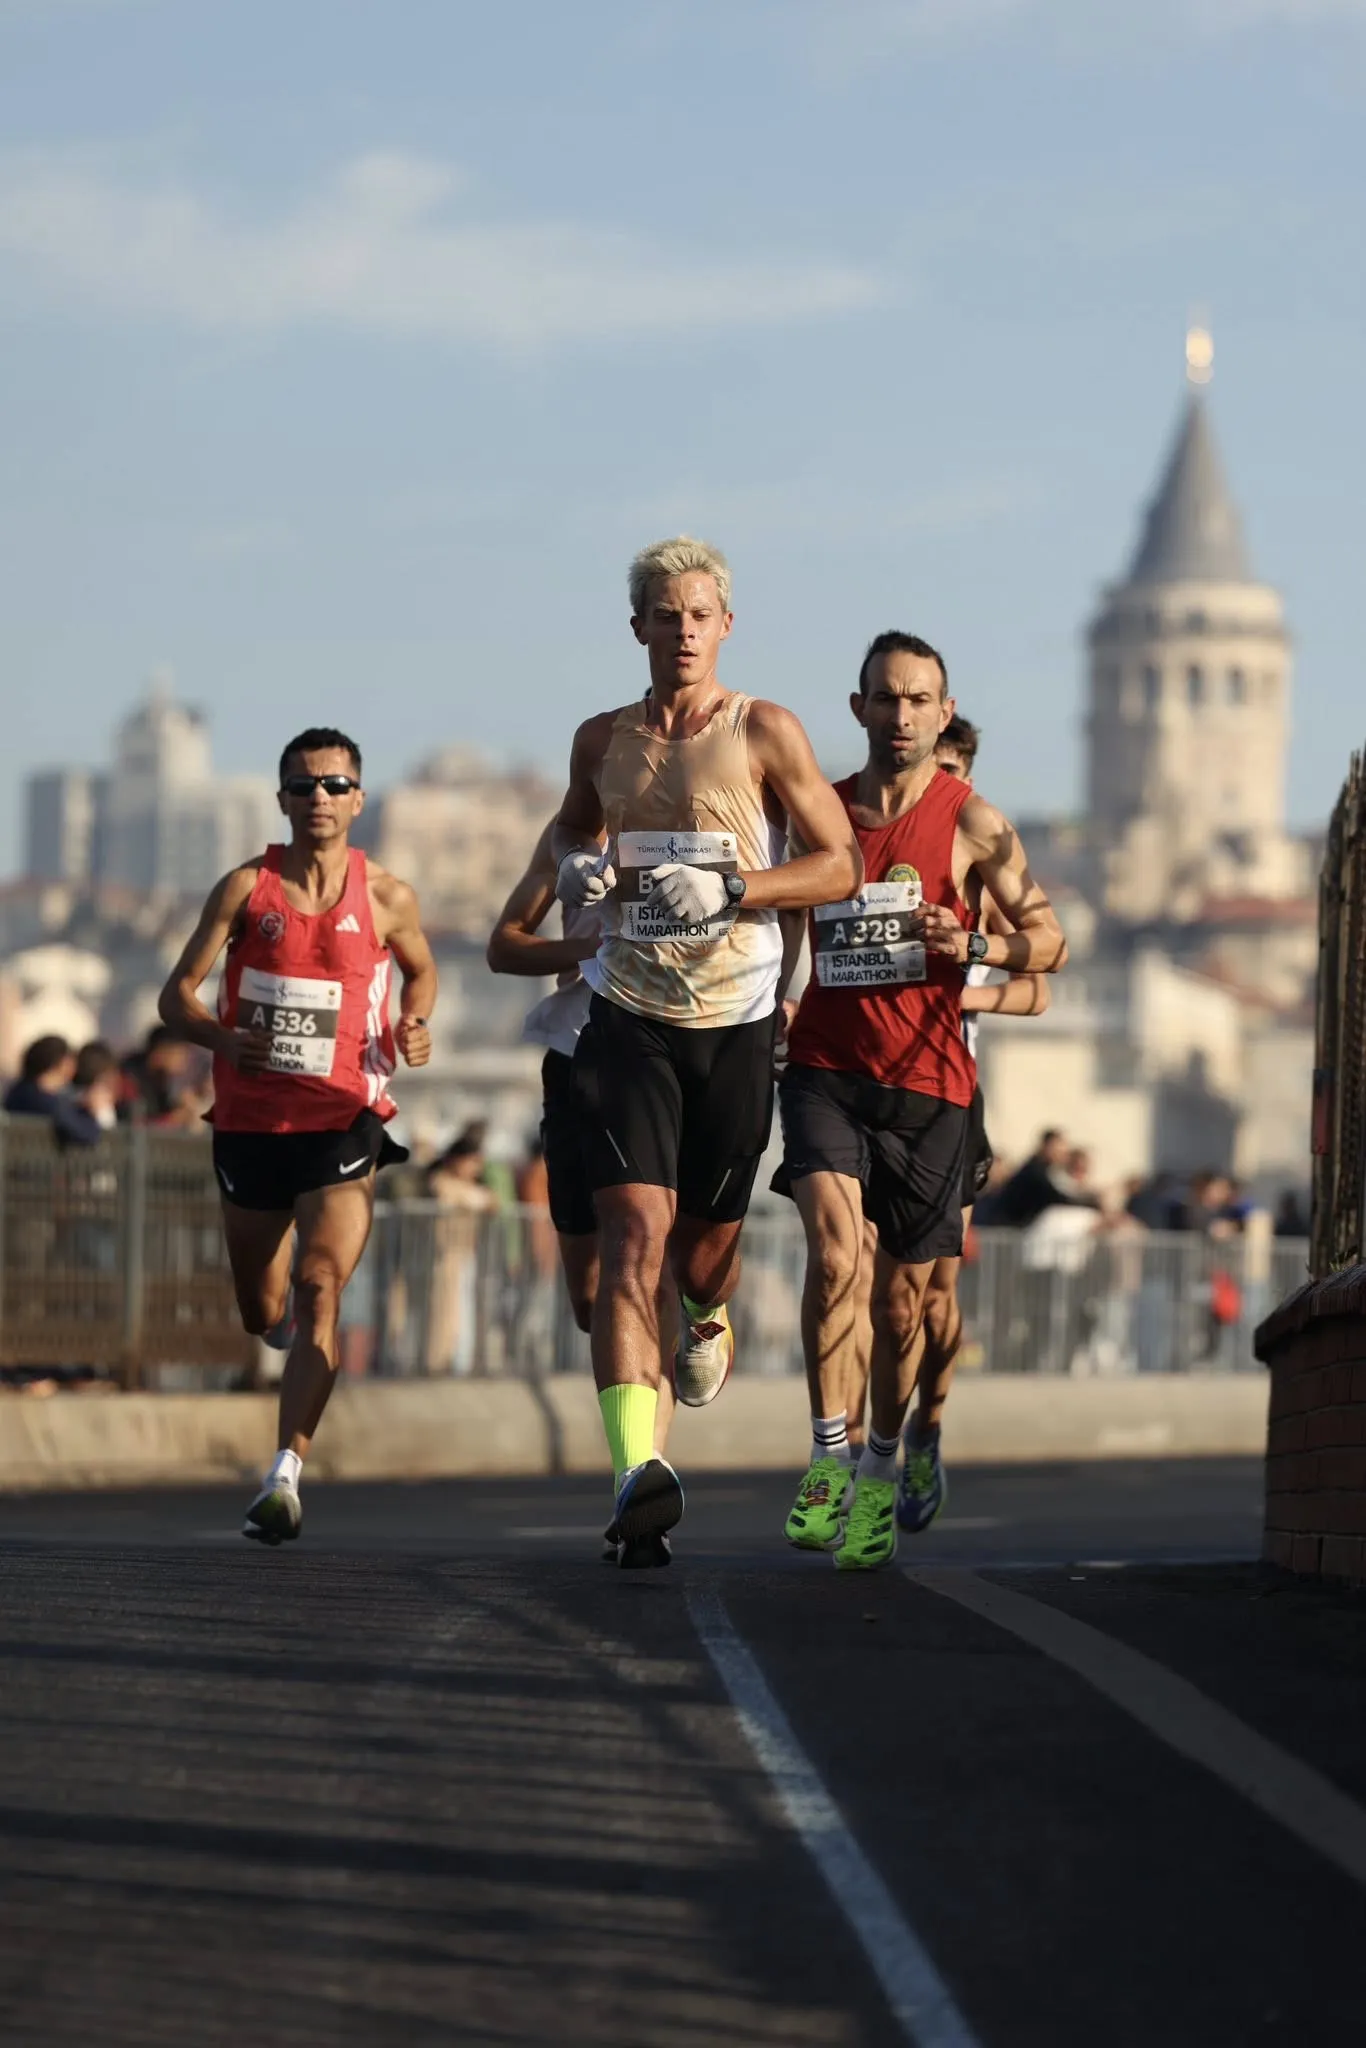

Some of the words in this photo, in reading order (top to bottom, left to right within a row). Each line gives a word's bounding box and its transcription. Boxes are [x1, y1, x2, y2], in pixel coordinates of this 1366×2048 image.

[638, 870, 653, 894] B
[638, 905, 666, 921] ISTA
[637, 924, 708, 937] MARATHON
[832, 922, 848, 944] A
[852, 918, 901, 943] 328
[832, 952, 896, 968] ISTANBUL
[831, 968, 897, 983] MARATHON
[252, 1006, 266, 1028] A
[272, 1010, 316, 1035] 536
[271, 1041, 305, 1056] NBUL
